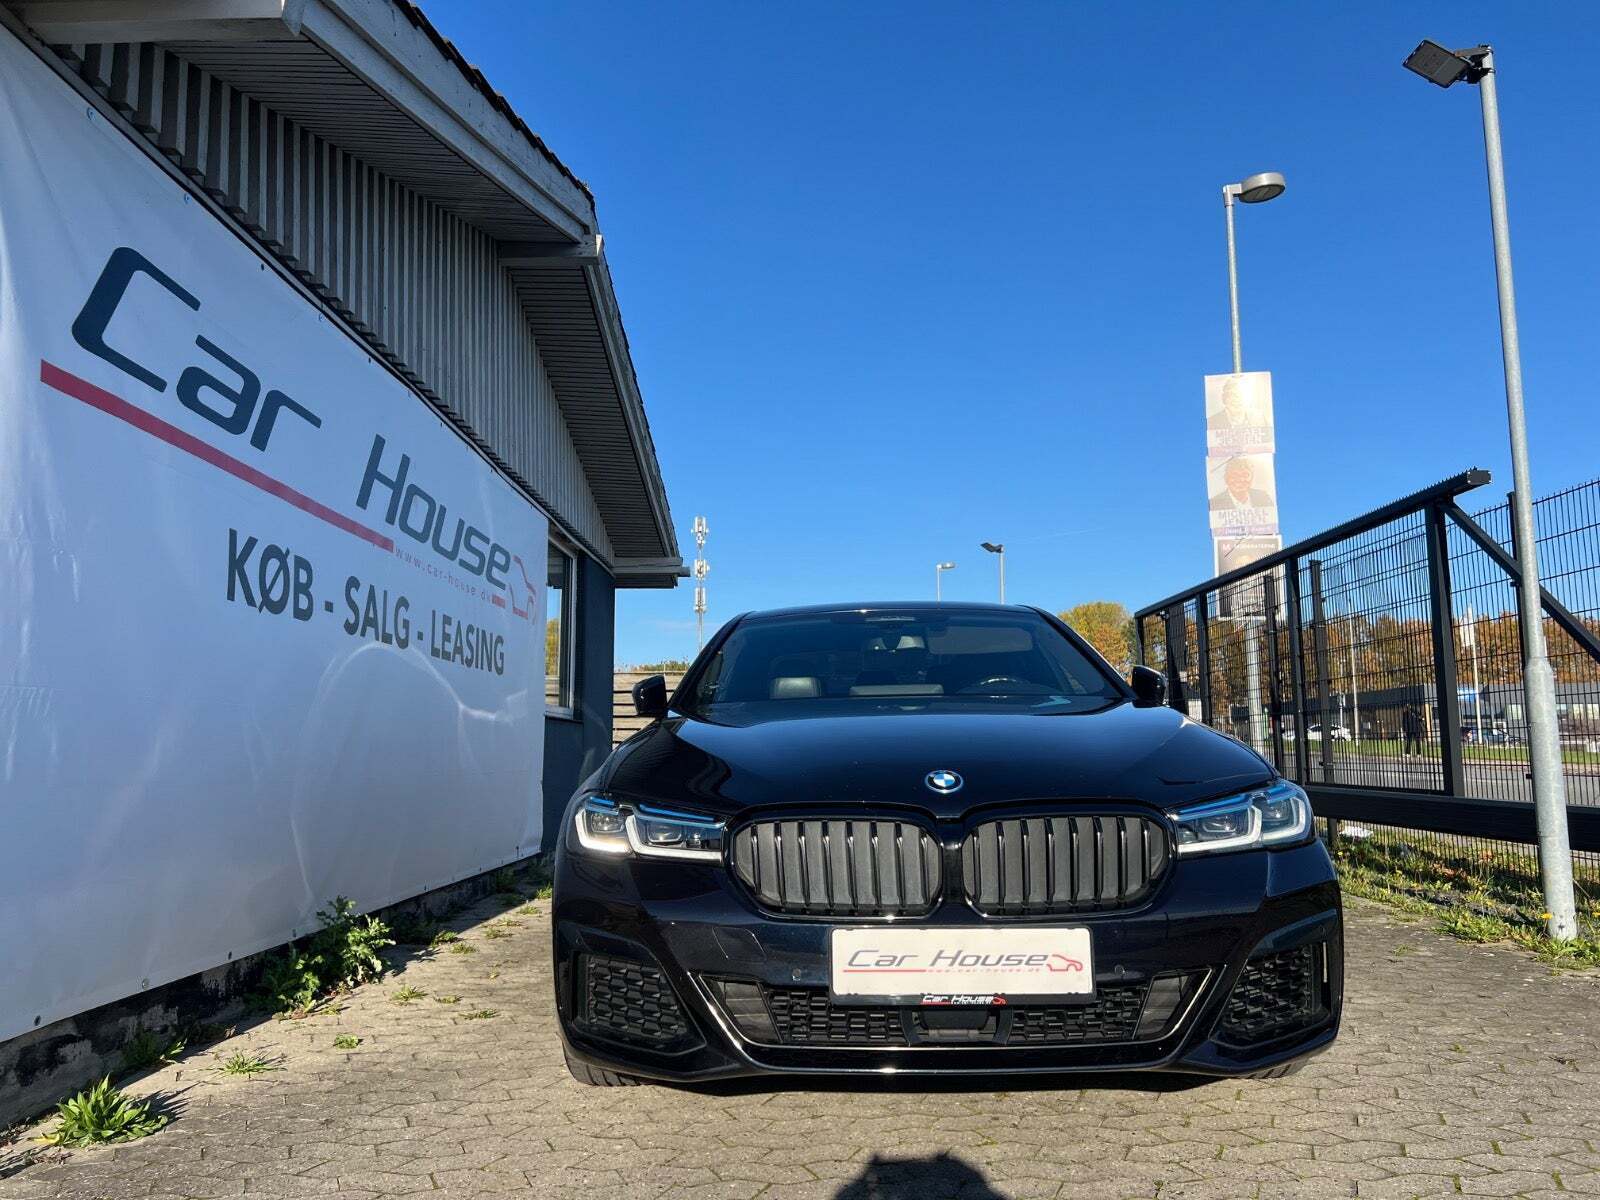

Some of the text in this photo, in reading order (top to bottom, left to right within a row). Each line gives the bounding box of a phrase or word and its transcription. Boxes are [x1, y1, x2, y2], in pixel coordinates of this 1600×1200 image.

[71, 247, 511, 591] Car House
[226, 528, 314, 621] KØB
[343, 575, 410, 650] SALG
[430, 609, 504, 676] LEASING
[848, 949, 1049, 967] Car House
